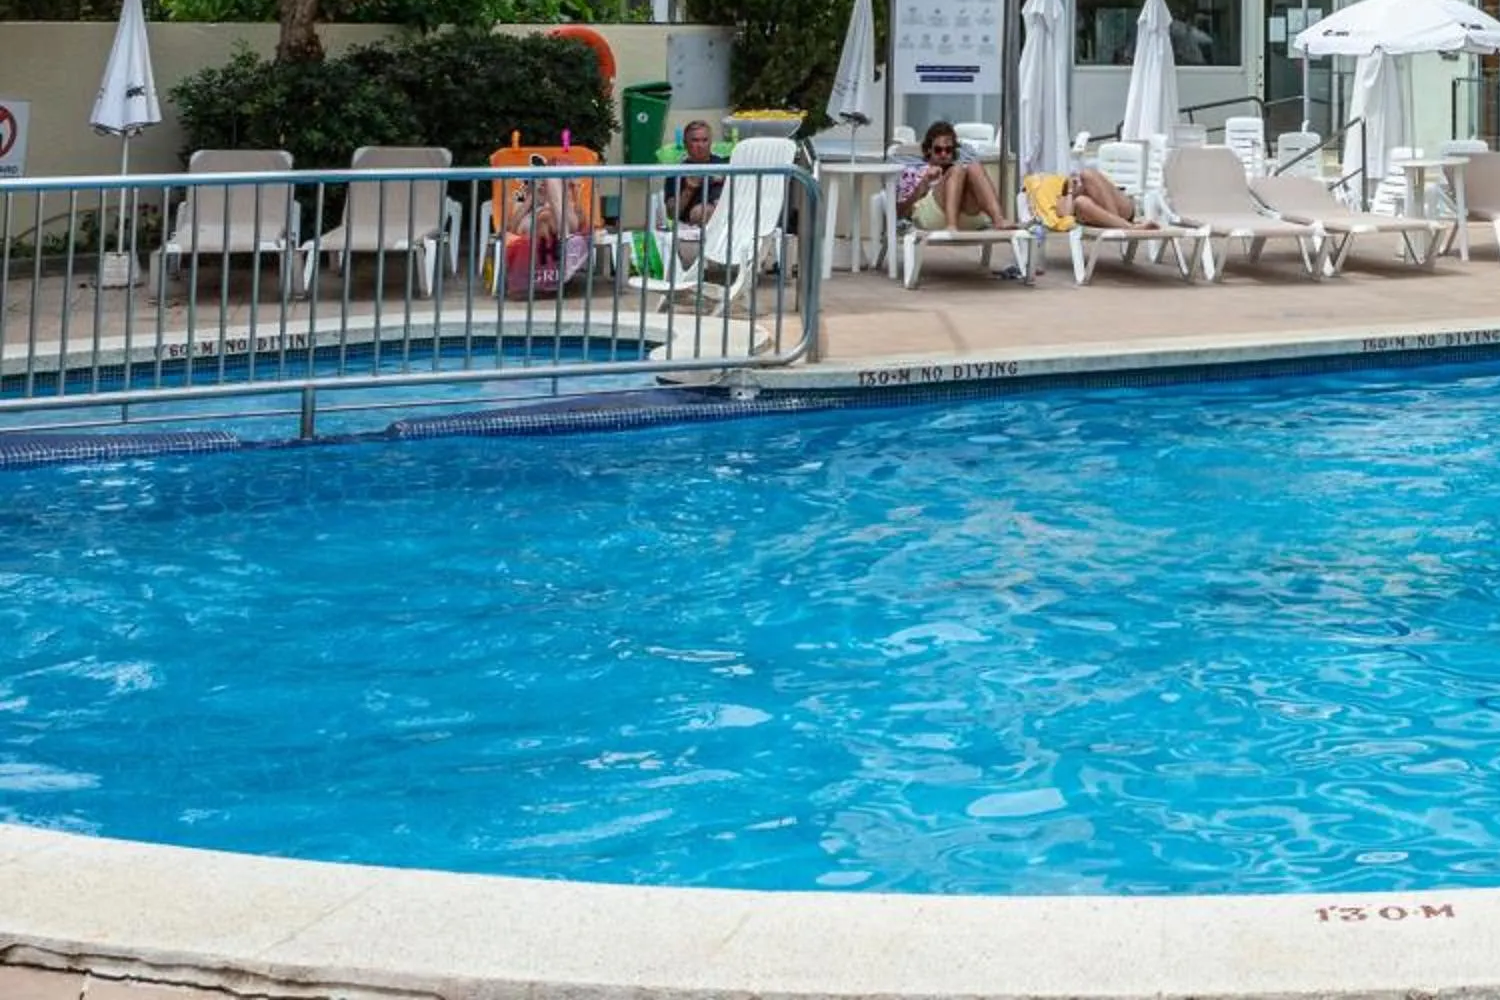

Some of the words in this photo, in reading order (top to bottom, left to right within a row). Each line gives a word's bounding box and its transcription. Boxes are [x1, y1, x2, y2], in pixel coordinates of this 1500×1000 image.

[225, 338, 247, 352] NO
[257, 333, 316, 351] DIIN
[1417, 332, 1437, 347] NO
[1445, 329, 1500, 346] DIVING
[921, 365, 943, 381] NO
[953, 361, 1019, 379] DIVING
